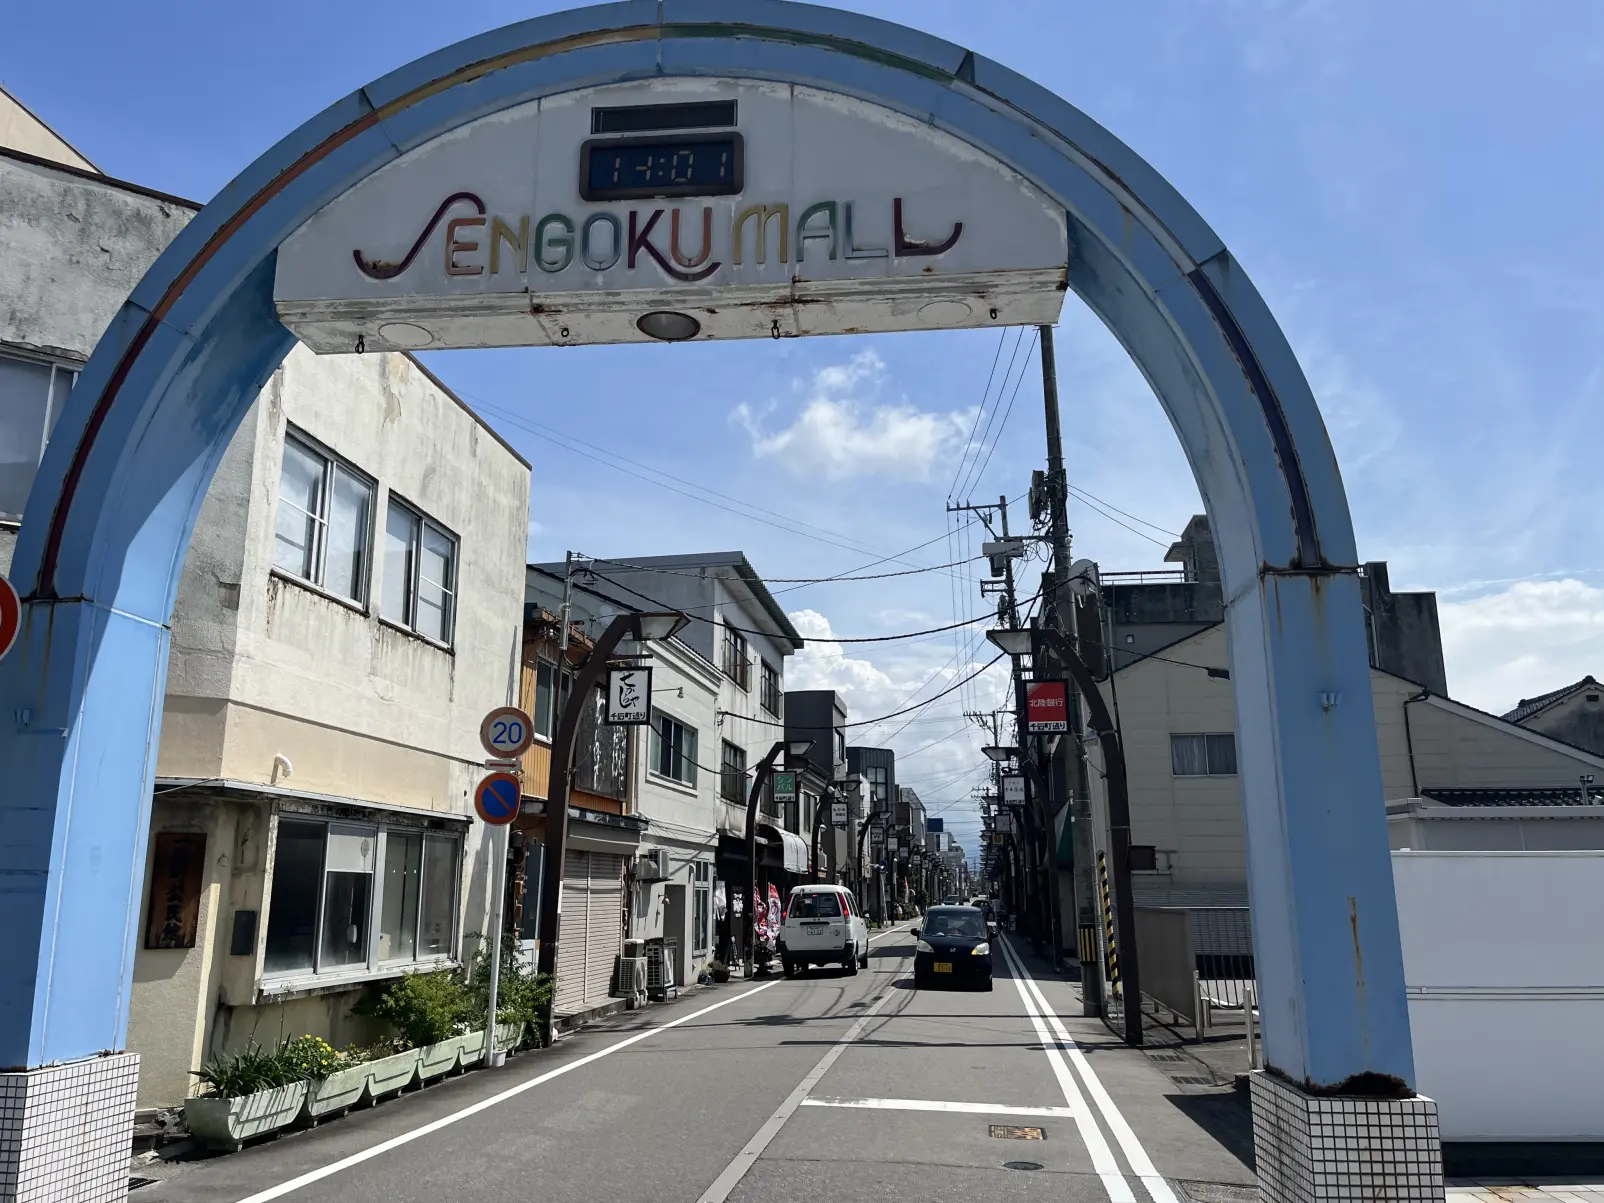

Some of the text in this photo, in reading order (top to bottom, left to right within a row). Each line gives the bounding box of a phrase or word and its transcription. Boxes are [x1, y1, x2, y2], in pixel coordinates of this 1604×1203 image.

[353, 191, 964, 281] SENGOKU MALL
[1029, 698, 1064, 707] 北陸銀行
[609, 711, 646, 721] 千石町通り
[1029, 722, 1067, 731] 千石町通り
[492, 721, 523, 745] 20
